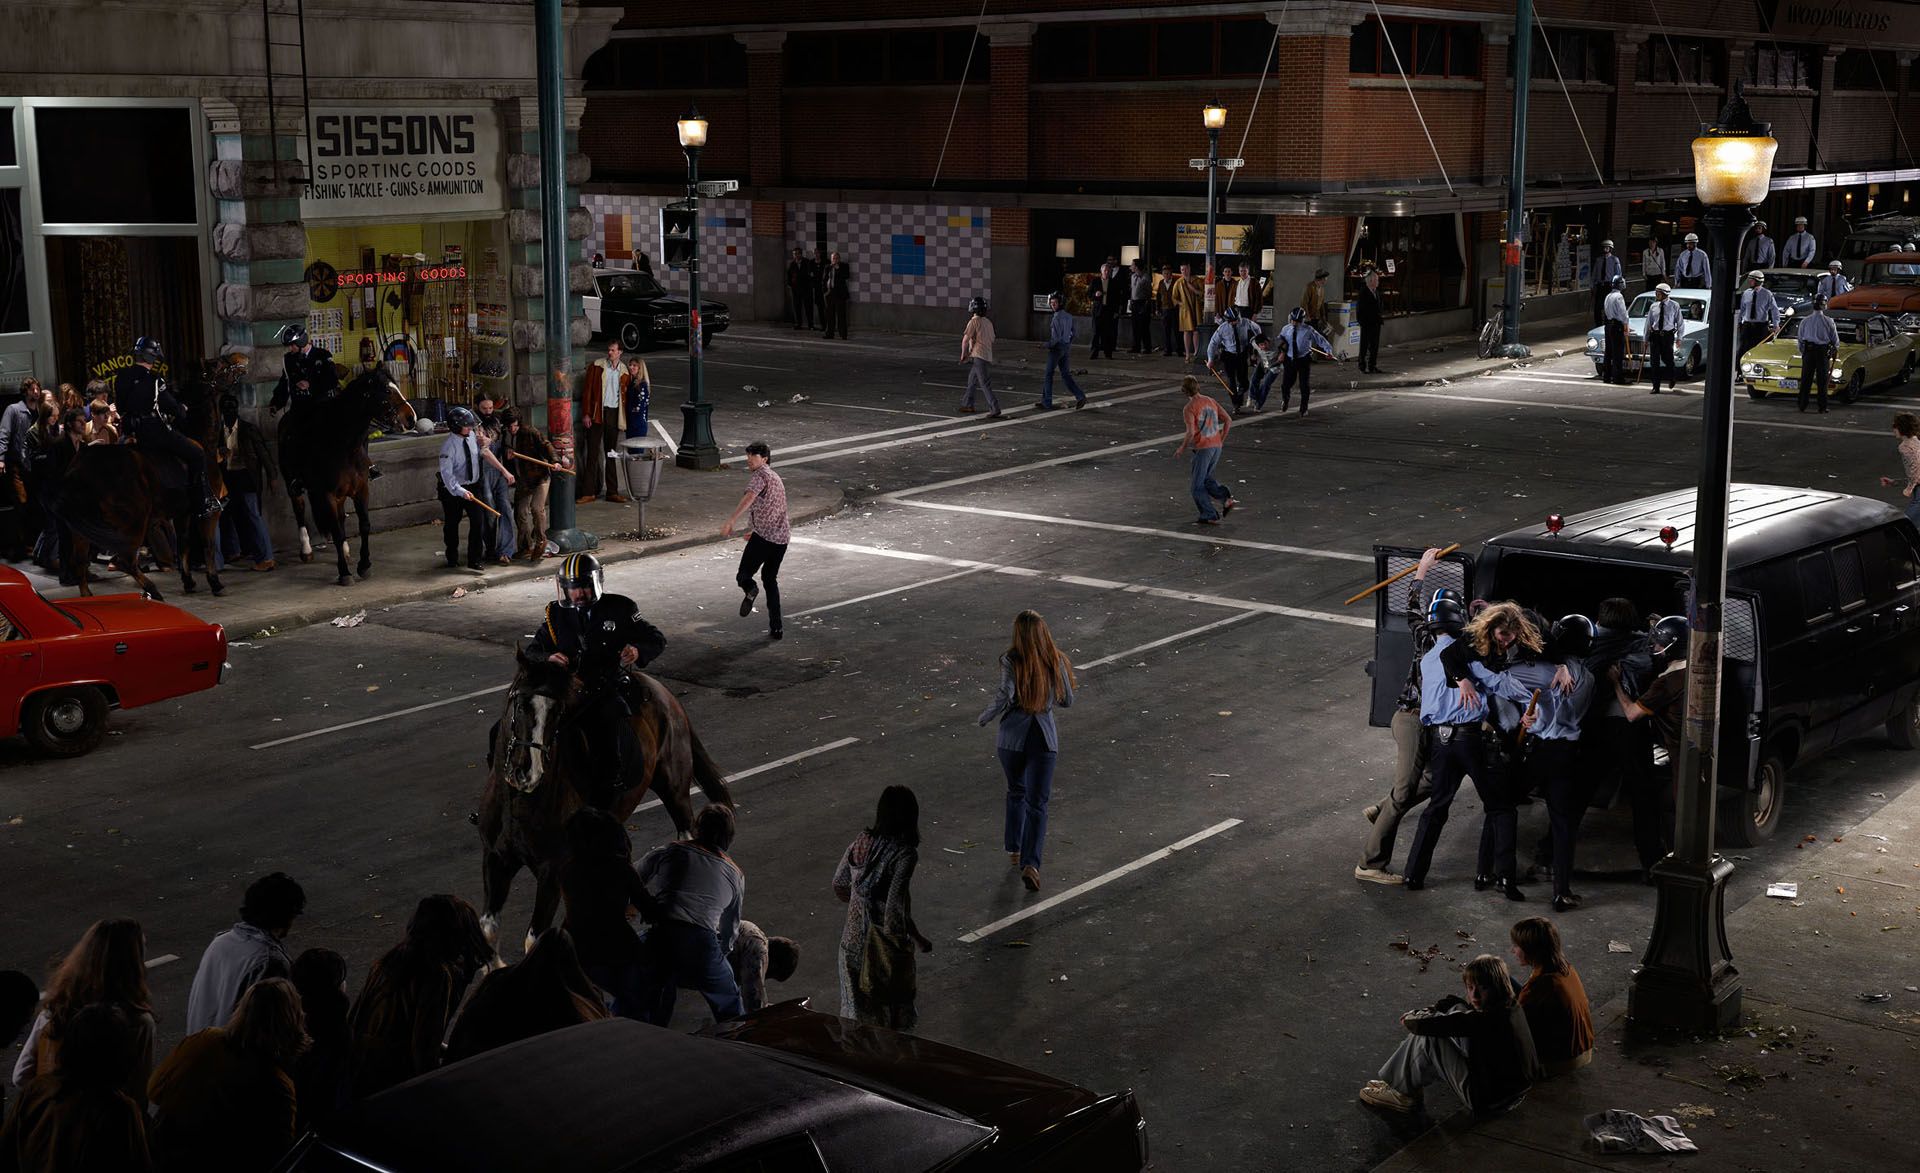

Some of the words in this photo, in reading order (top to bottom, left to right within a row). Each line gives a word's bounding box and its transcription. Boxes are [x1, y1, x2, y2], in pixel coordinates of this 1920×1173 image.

[316, 115, 475, 156] SISSONS
[318, 163, 411, 179] SPORTING
[417, 161, 476, 177] GOODS
[304, 184, 346, 199] FISHING
[348, 182, 383, 198] TACKLE
[390, 181, 418, 197] GUNS
[427, 180, 484, 195] AMMUNITION
[337, 271, 406, 286] SPORTING
[421, 267, 466, 280] GOODS
[92, 355, 169, 377] VANCOER
